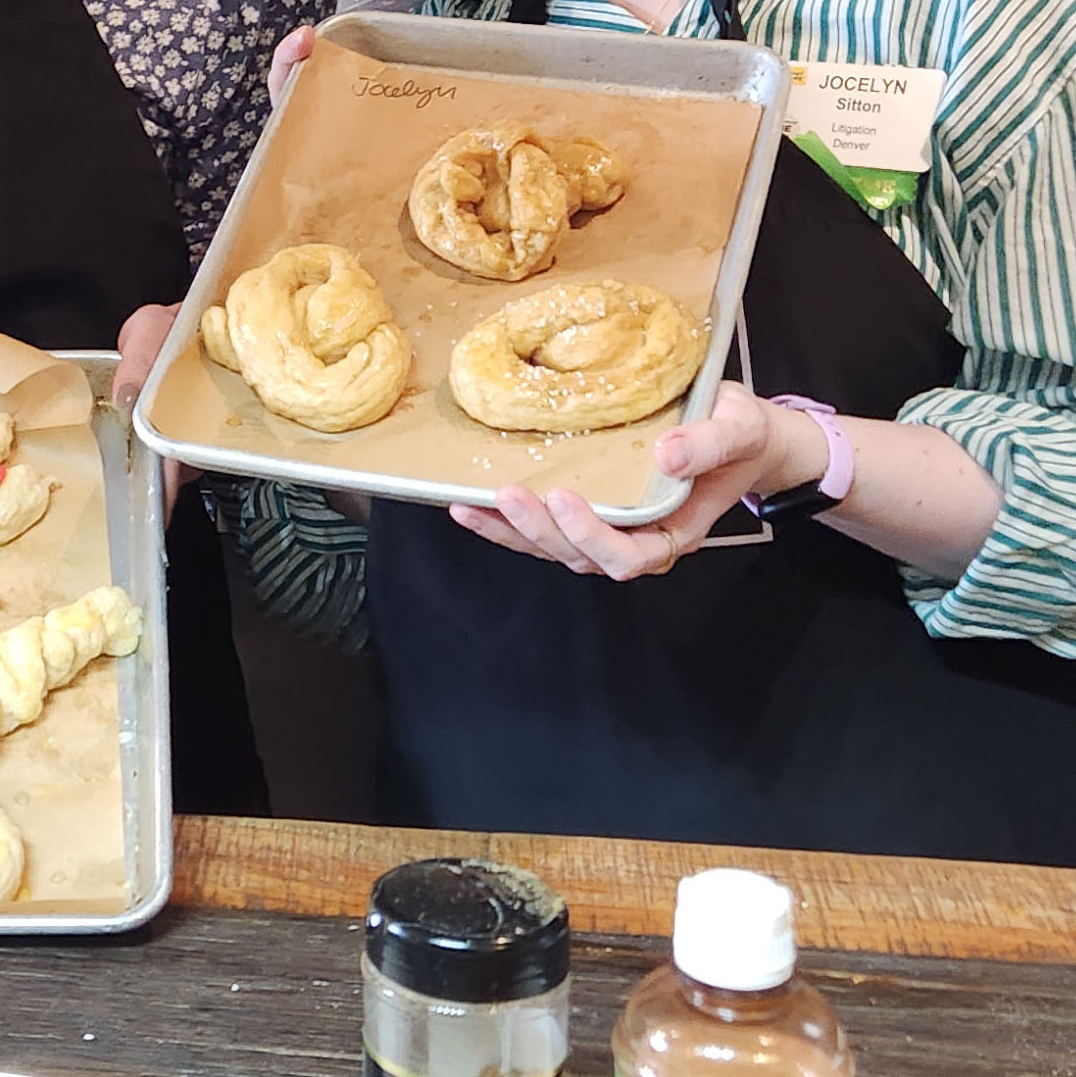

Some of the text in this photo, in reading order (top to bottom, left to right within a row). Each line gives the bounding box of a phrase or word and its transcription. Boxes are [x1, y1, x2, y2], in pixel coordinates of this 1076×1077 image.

[352, 76, 457, 109] Jocelyn
[819, 74, 908, 95] JOCELYN
[836, 97, 882, 114] Sitton
[831, 123, 877, 136] Litigation
[833, 138, 871, 151] Denver
